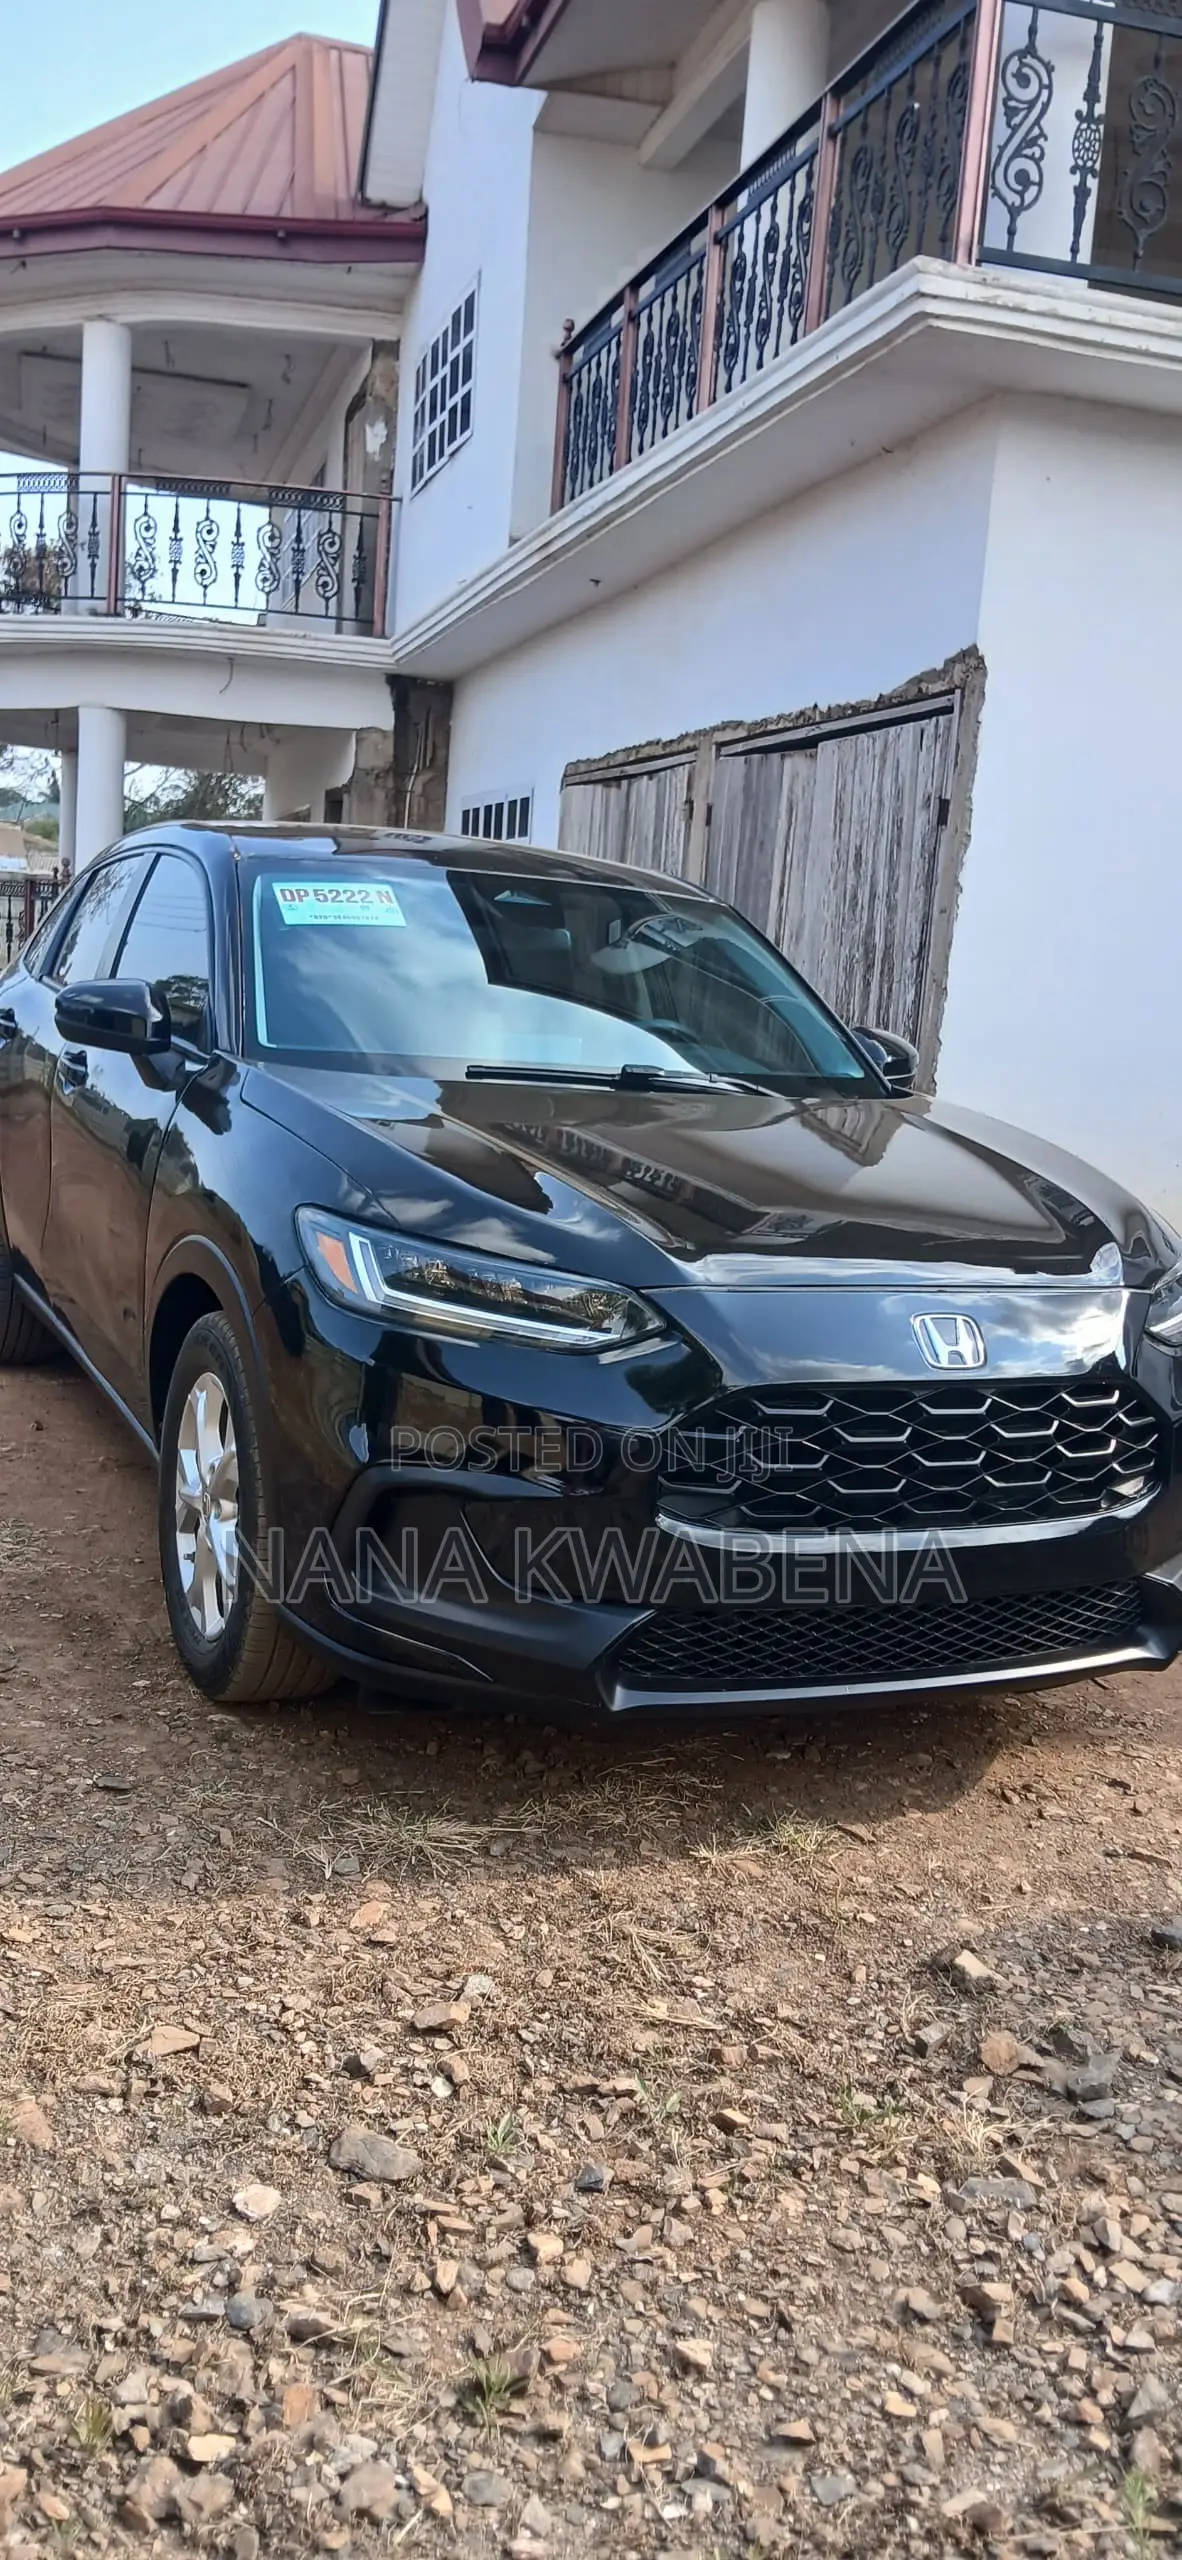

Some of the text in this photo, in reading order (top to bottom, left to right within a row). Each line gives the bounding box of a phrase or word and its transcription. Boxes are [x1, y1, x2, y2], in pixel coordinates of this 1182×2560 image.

[279, 888, 394, 904] DP 5222 N
